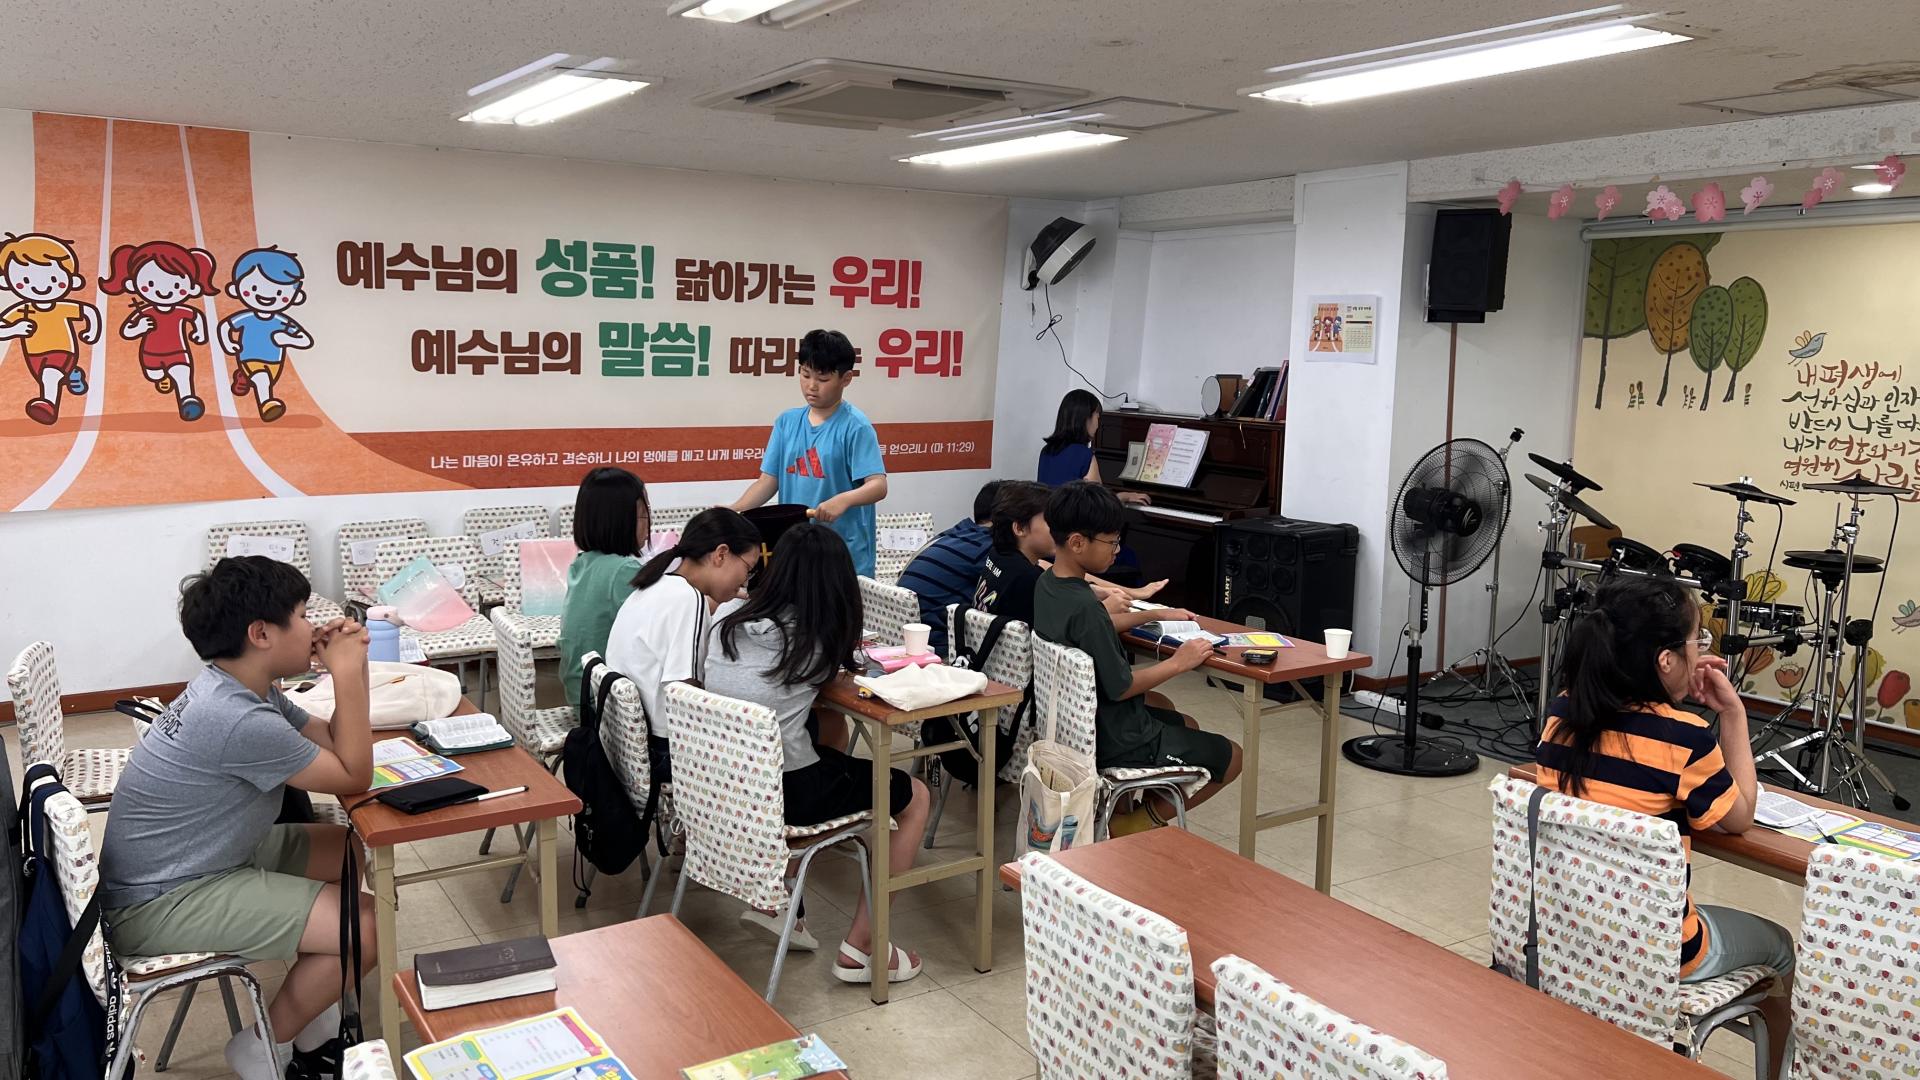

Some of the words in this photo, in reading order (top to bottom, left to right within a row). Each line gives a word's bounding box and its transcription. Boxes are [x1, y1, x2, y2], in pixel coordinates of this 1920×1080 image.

[336, 240, 518, 294] 예수님의
[535, 238, 655, 299] 성품!
[675, 258, 816, 305] 닮아가는
[829, 255, 922, 309] 우리!
[411, 329, 582, 375] 예수님의
[598, 321, 711, 377] 말씀!
[729, 336, 862, 377] 따라
[875, 327, 964, 378] 우리!
[1789, 411, 1842, 433] 반드시
[1848, 414, 1894, 438] 나를
[431, 456, 459, 469] 나는
[463, 454, 503, 468] 마음이
[507, 452, 559, 467] 온유하고
[562, 451, 612, 465] 겸손하니
[615, 451, 640, 463] 나의
[643, 450, 678, 463] 멍에를
[681, 449, 704, 462] 메고
[707, 448, 729, 461] 내게
[889, 443, 927, 456] 얻으리니
[930, 442, 943, 455] (마
[946, 441, 975, 454] 11:29)
[1783, 435, 1826, 453] 내가
[1783, 454, 1841, 477] 영원히
[1779, 480, 1800, 492] 시편
[107, 995, 117, 1041] adidas
